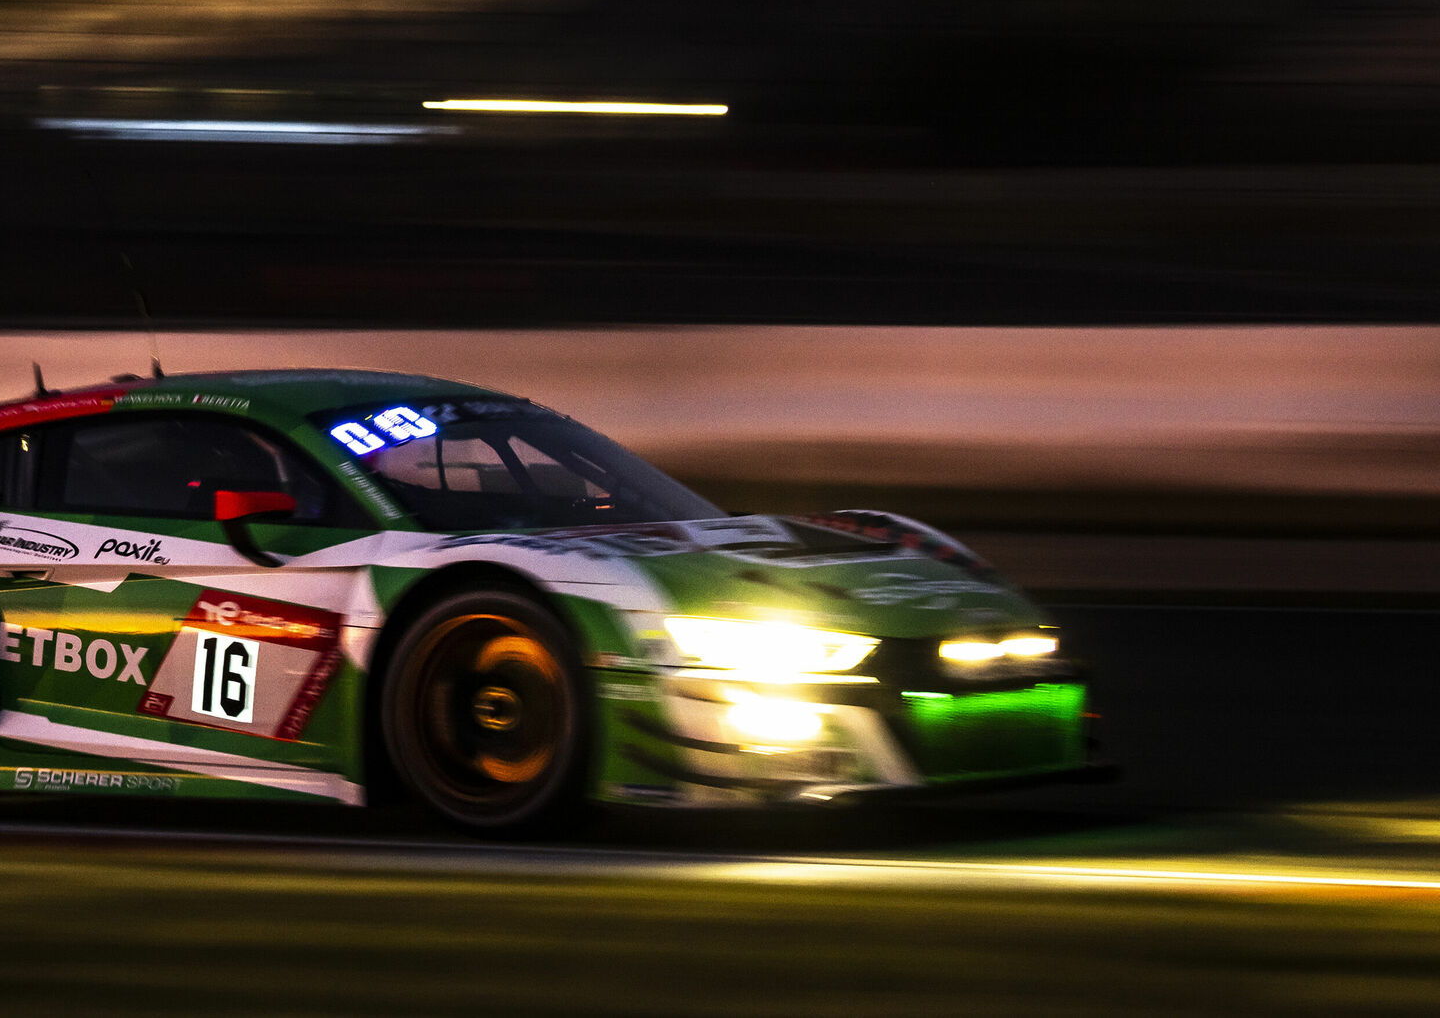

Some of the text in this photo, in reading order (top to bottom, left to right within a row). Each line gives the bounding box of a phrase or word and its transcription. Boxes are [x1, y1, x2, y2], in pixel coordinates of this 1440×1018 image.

[200, 395, 250, 410] BERETTA
[12, 537, 74, 559] INDUSTRY
[203, 637, 249, 718] 16
[37, 769, 123, 788] SCHERER
